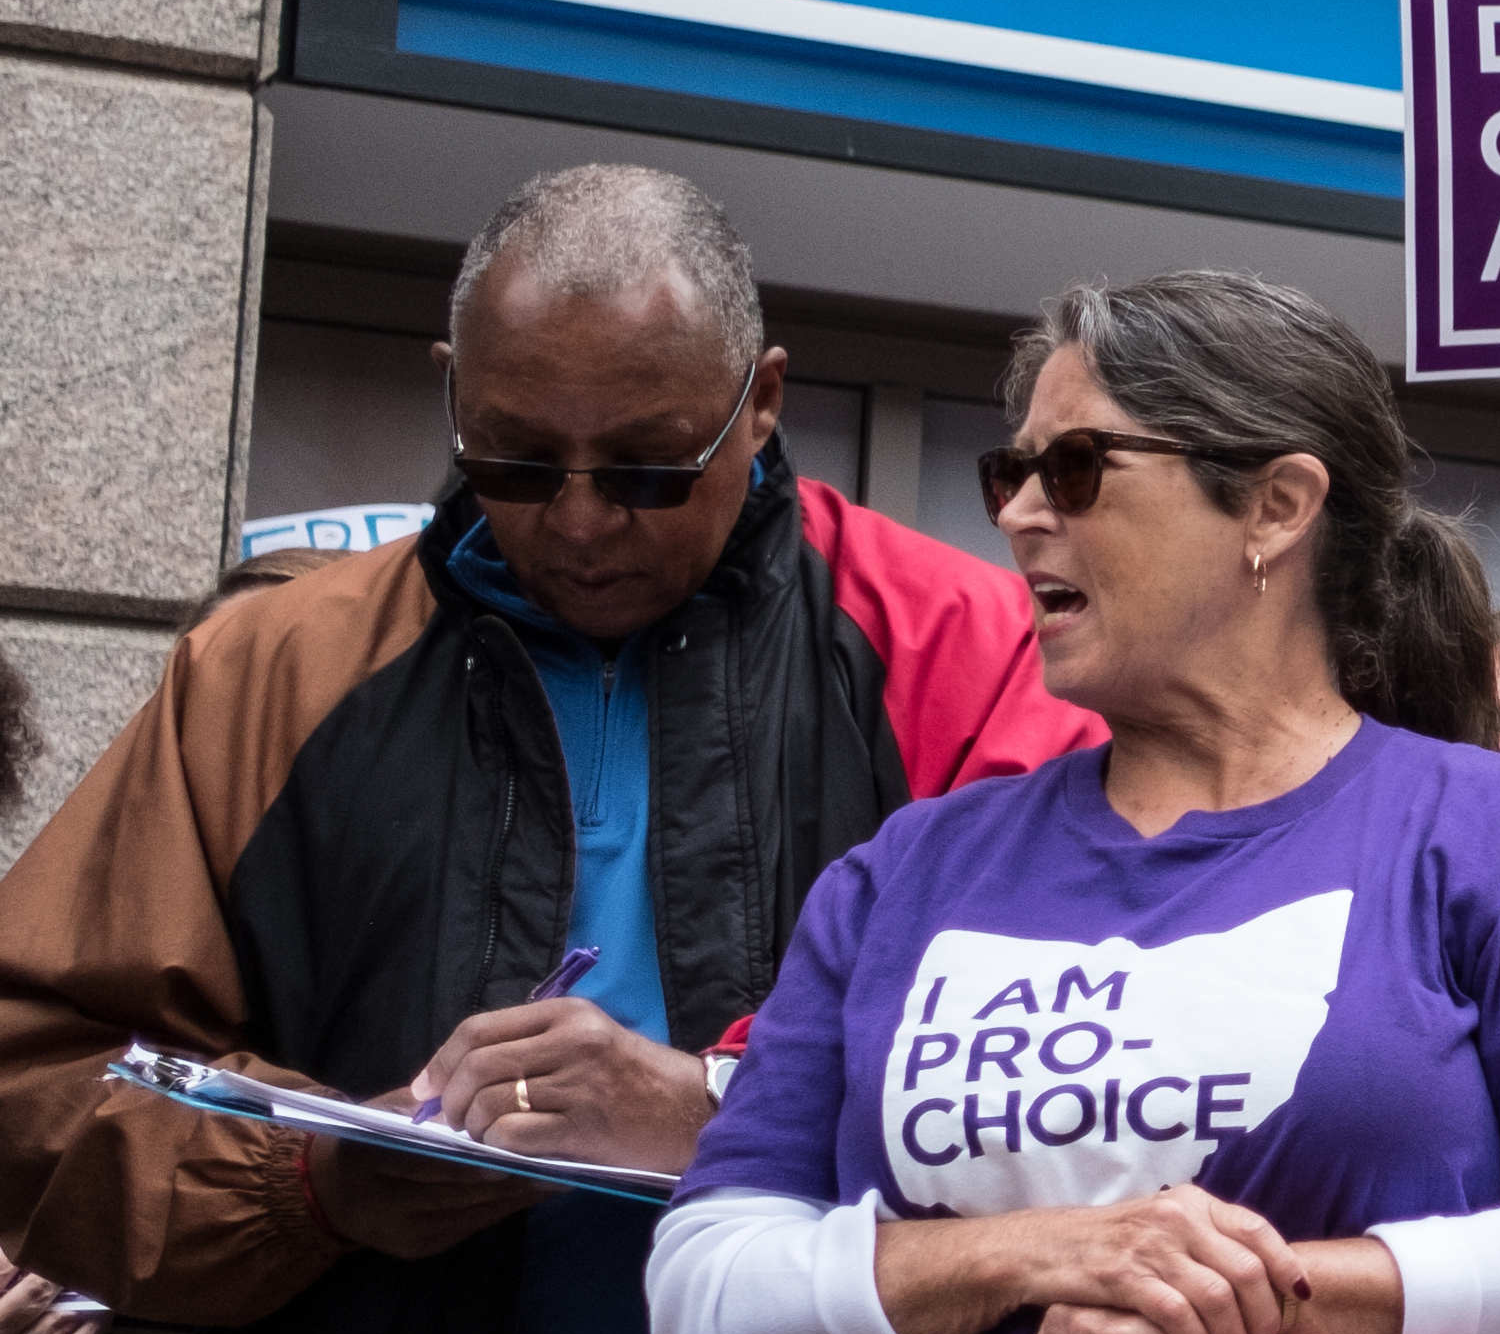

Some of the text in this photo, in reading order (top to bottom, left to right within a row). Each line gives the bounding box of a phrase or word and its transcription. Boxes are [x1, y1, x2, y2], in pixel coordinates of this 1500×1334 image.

[919, 963, 1128, 1025] I AM
[902, 1020, 1153, 1093] PRO-
[901, 1071, 1253, 1167] CHOICE
